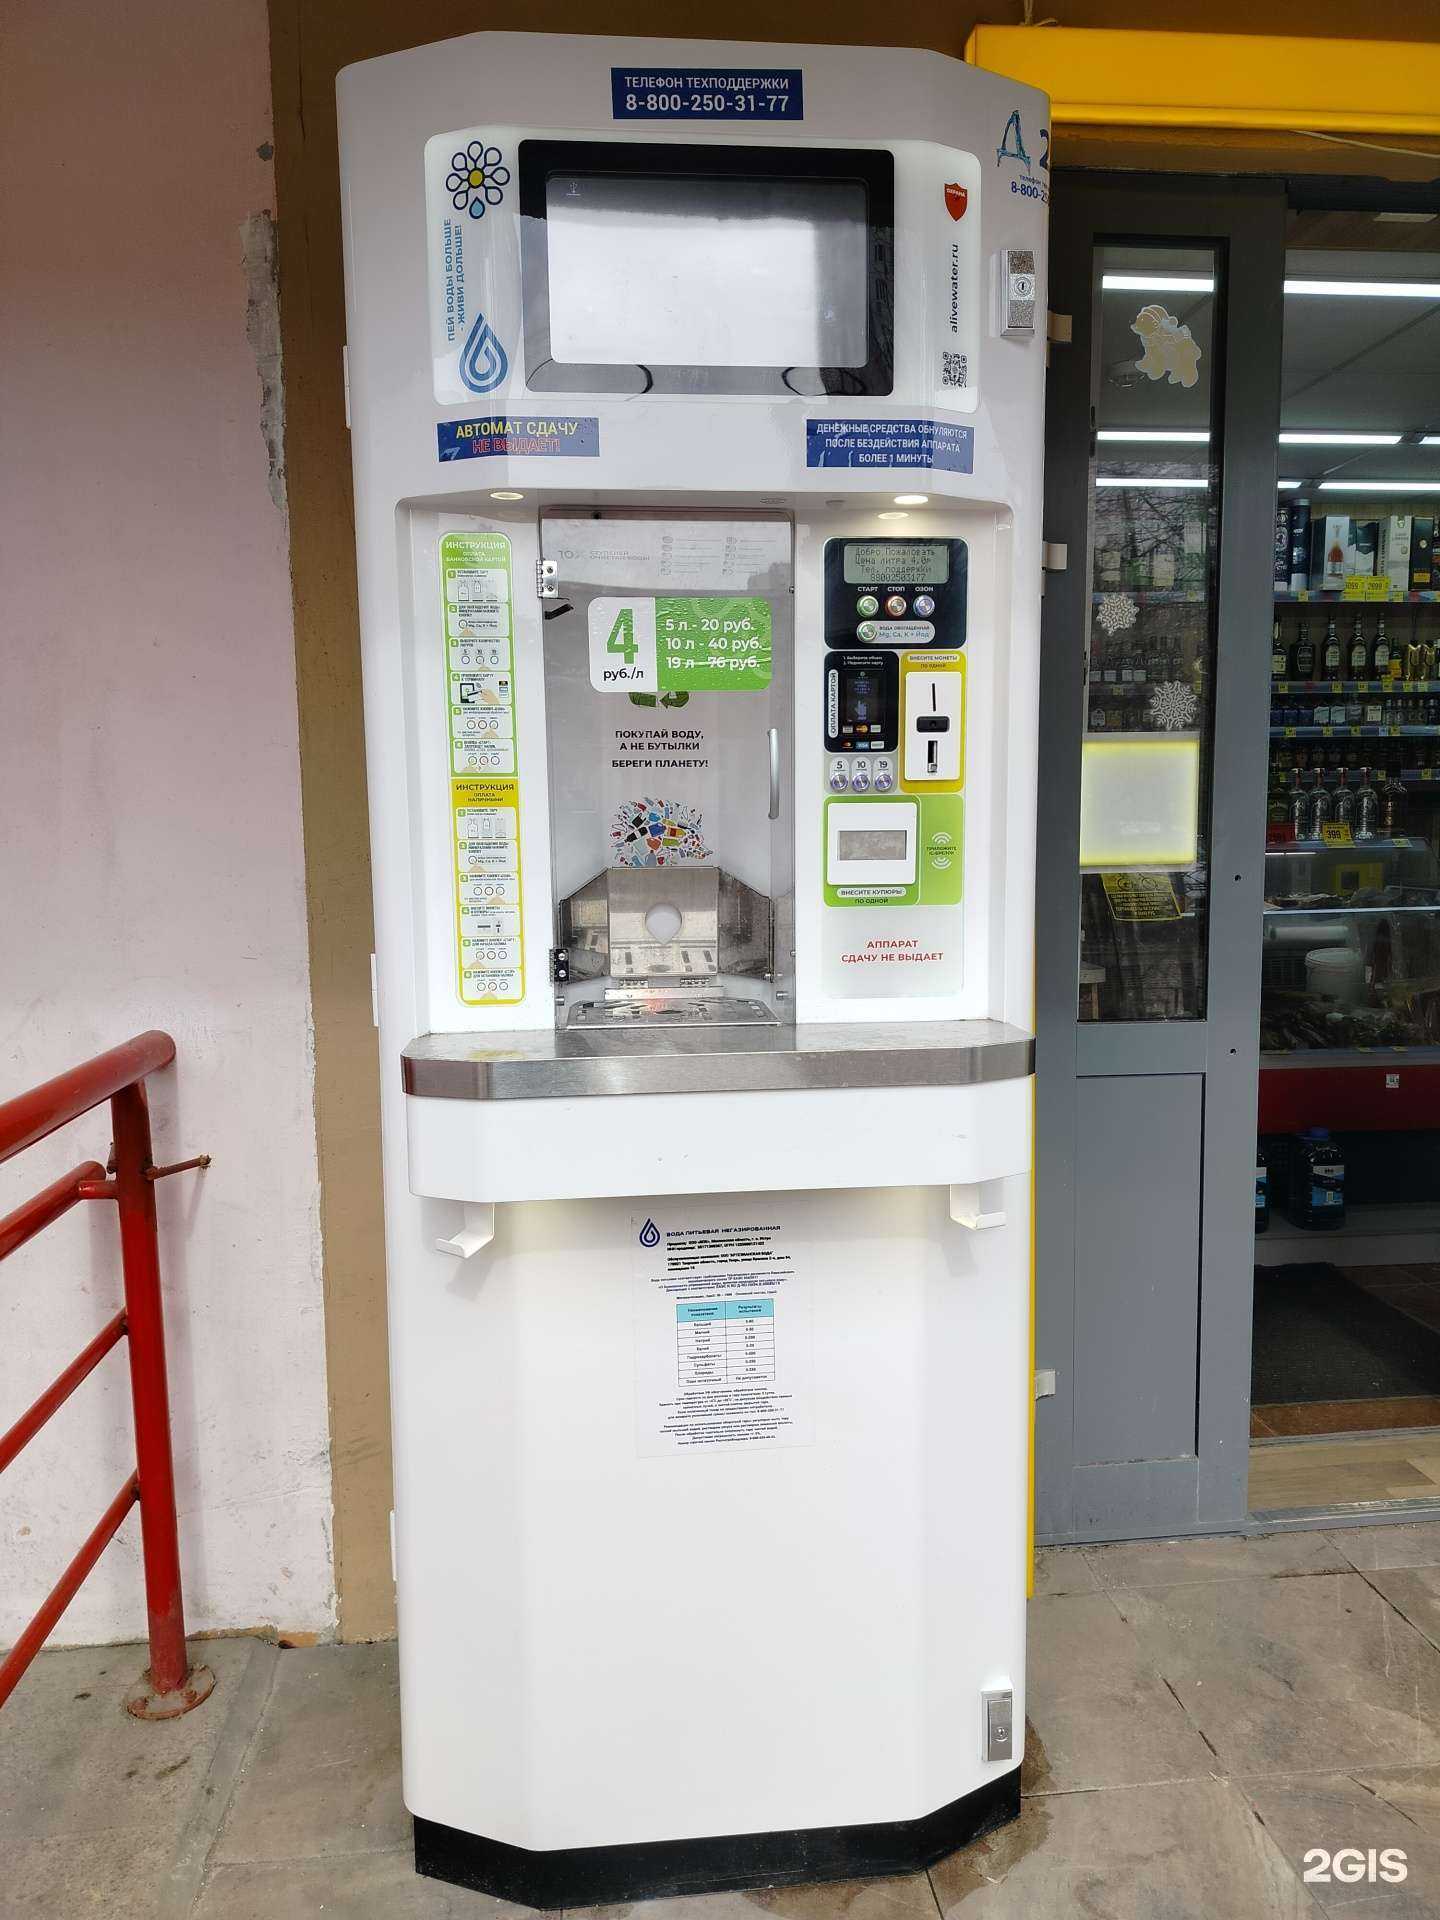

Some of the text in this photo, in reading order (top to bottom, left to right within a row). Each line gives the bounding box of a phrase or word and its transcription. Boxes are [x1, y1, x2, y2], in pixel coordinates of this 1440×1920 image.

[624, 76, 788, 90] ТЕЛЕФОН ТЕХПОДДЕРЖКИ
[626, 94, 789, 111] 8-800-250-31-77
[443, 219, 455, 341] ПЕЙ ВОДЫ БОЛЬШЕ
[949, 244, 959, 333] alivewater.ru
[456, 421, 578, 438] АВТОМАТ СДАЧУ
[816, 423, 967, 439] ДЕНЕЖНЫЕ СРЕДСТВА ОБНУЛЯЮТСЯ
[472, 437, 560, 454] НЕ ВЫДАЕТ!
[825, 438, 960, 452] ПОСЛЕ БЕЗДЕЙСТВИЯ АППАРАТА
[859, 453, 933, 463] БОЛЕЕ 1 МИНУТЫ
[886, 547, 935, 556] Пожаловать
[665, 619, 675, 630] 5
[701, 619, 719, 630] 20
[723, 618, 755, 633] руб.
[607, 609, 639, 664] 4
[666, 638, 681, 650] 10
[685, 639, 695, 650] л
[708, 637, 727, 650] 40
[732, 637, 762, 652] руб.
[666, 656, 681, 668] 19
[708, 656, 725, 668] 76
[730, 656, 761, 670] руб.
[603, 667, 644, 680] руб./л
[830, 672, 838, 733] ОПЛАТА КАРТОЙ
[615, 729, 704, 739] ПОКУПАЙ ВОДУ,
[612, 760, 708, 768] БЕРЕГИ ПЛАНЕТУ!
[857, 760, 866, 768] 10
[879, 760, 888, 768] 19
[867, 940, 919, 948] АППАРАТ
[841, 952, 944, 963] СДАЧУ НЕ ВЫДАЕТ
[685, 1229, 719, 1237] ПИТЬЕВАЯ
